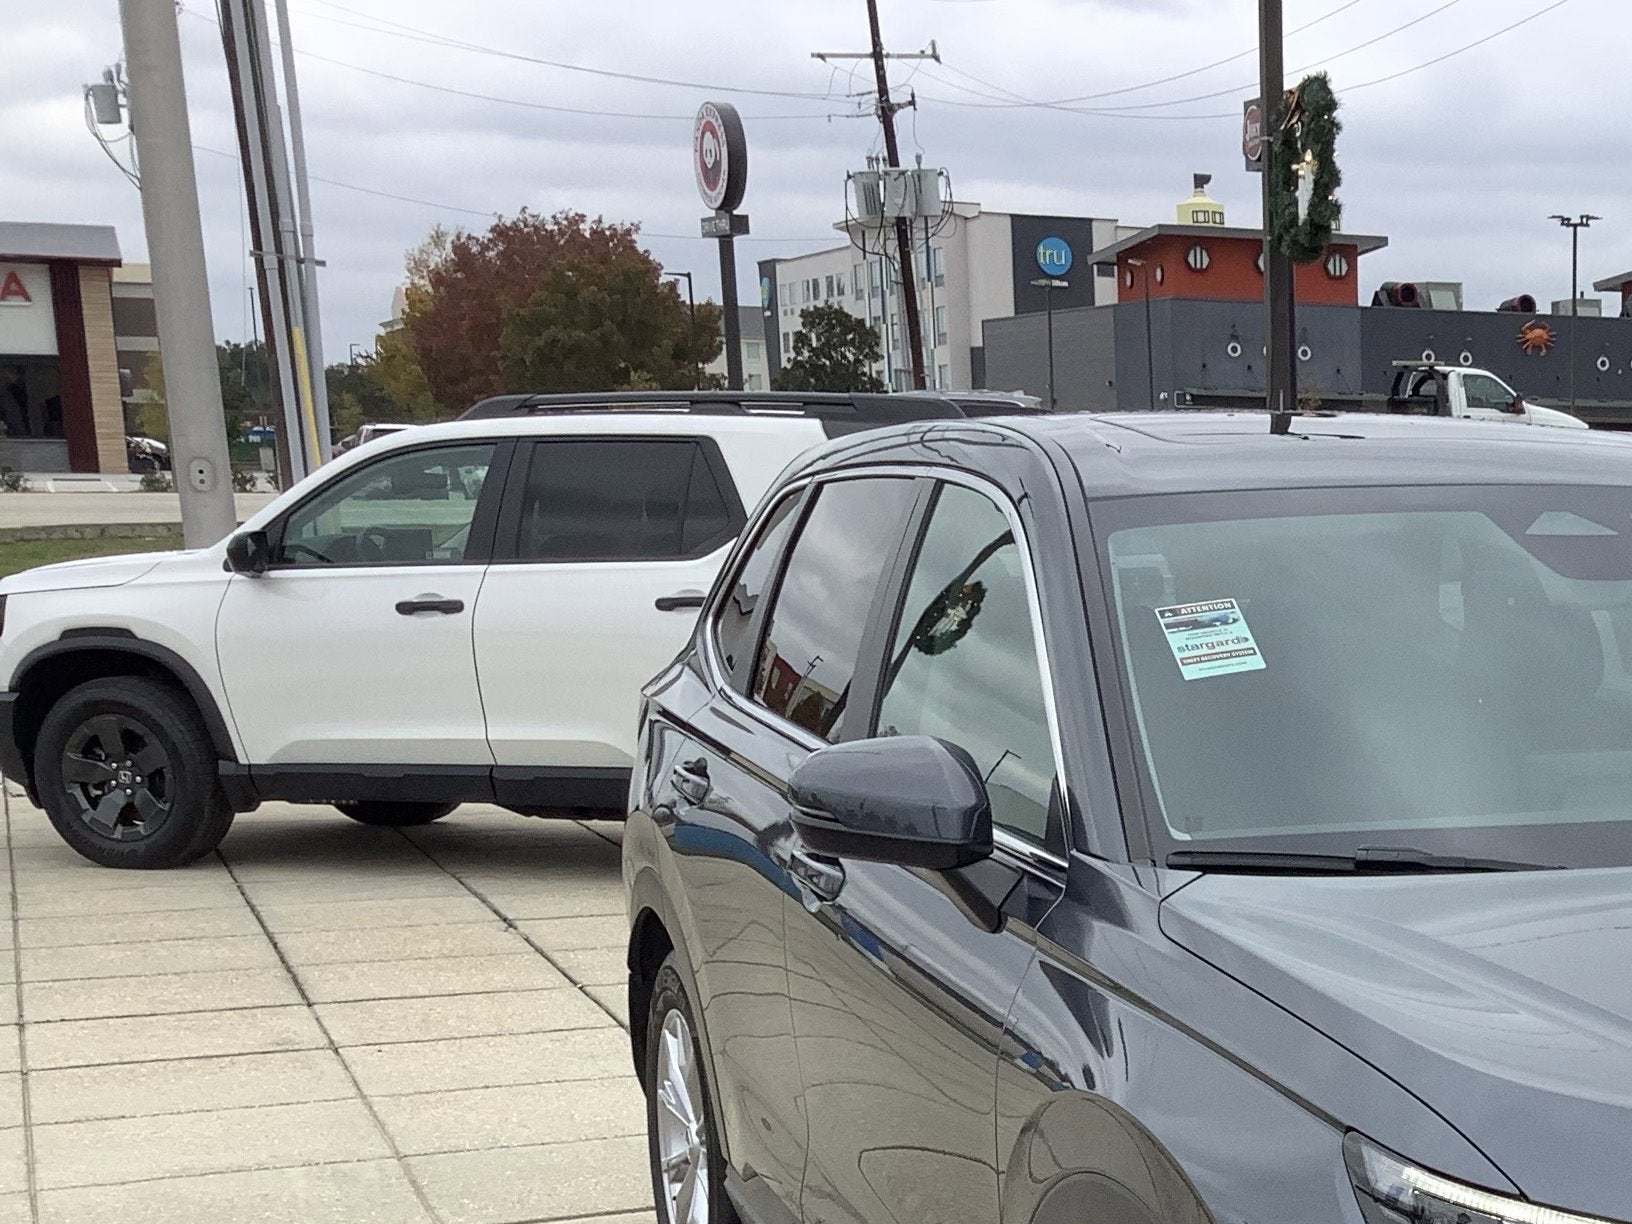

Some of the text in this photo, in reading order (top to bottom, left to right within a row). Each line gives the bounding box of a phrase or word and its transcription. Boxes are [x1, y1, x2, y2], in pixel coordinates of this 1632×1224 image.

[1039, 244, 1066, 265] tru
[1180, 602, 1232, 615] ATTENTION
[1177, 636, 1242, 653] stargard
